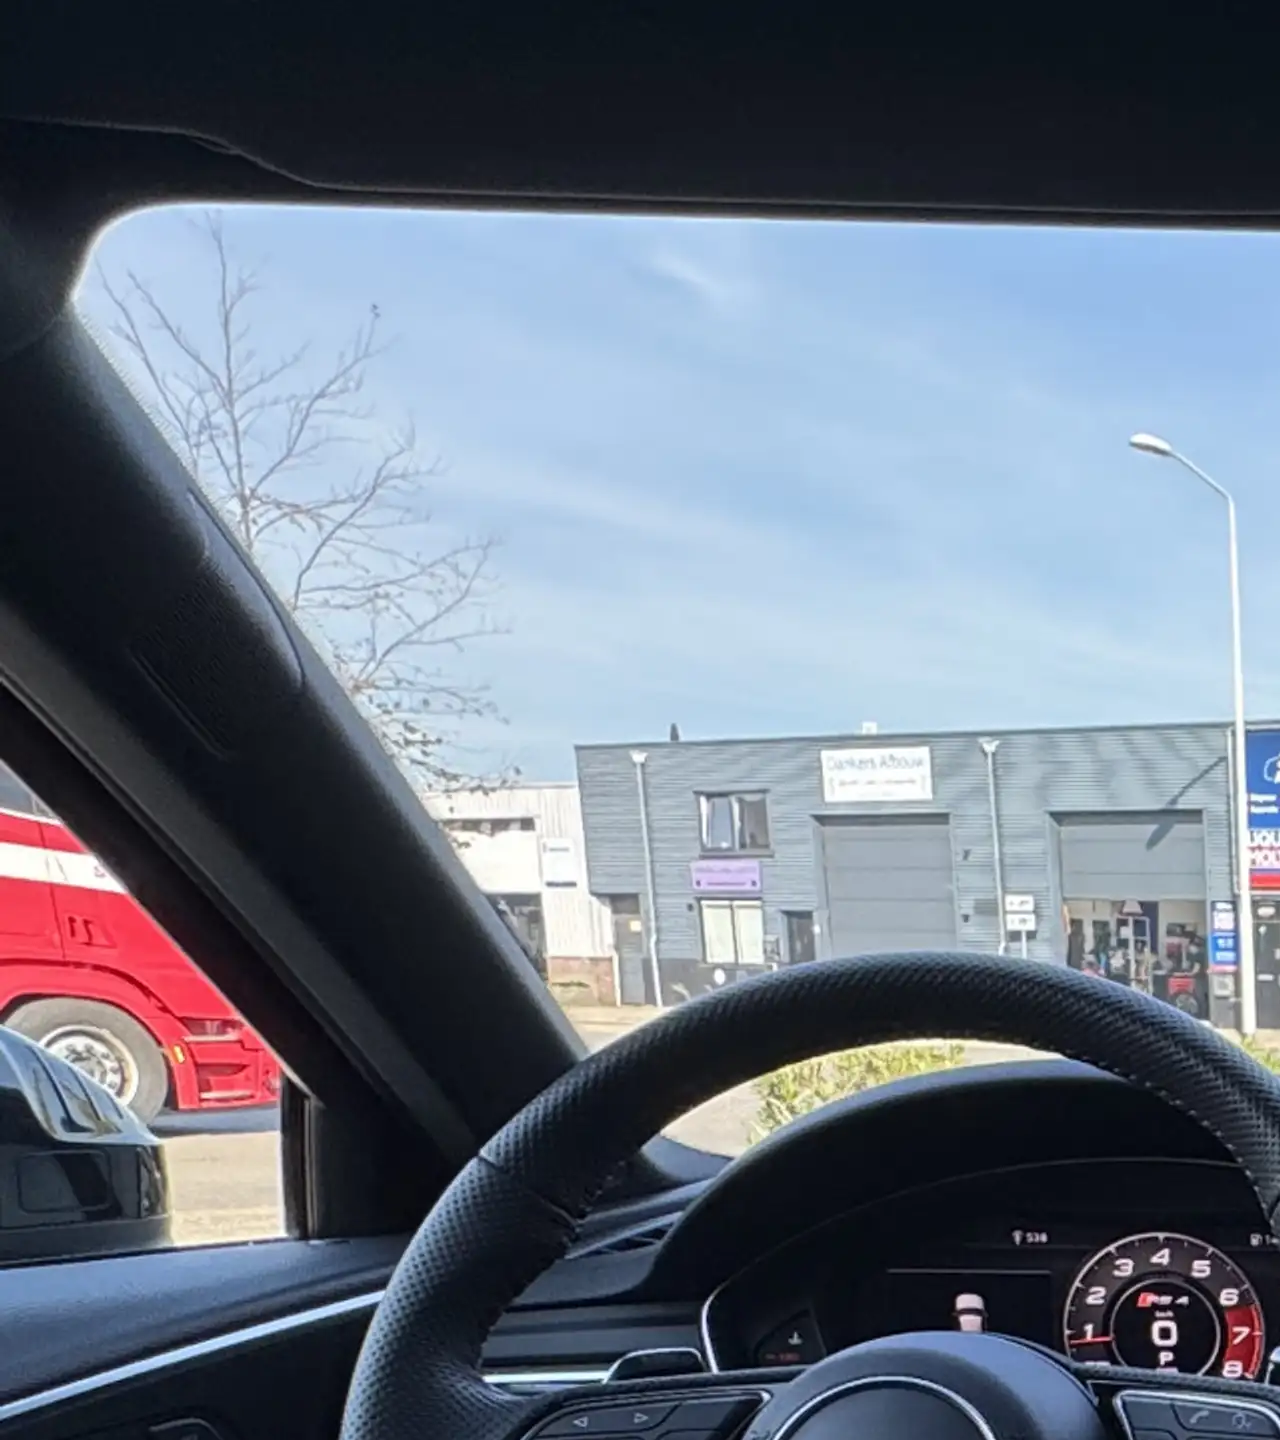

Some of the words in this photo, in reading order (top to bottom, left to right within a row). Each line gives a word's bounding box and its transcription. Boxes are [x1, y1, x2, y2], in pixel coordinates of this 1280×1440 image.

[1150, 1247, 1171, 1266] 4
[1113, 1258, 1135, 1278] 3
[1190, 1260, 1212, 1279] 5
[1085, 1286, 1107, 1305] 2
[1219, 1287, 1240, 1306] 6
[1083, 1323, 1094, 1341] 1
[1150, 1320, 1179, 1348] 0
[1231, 1326, 1250, 1345] 7
[1158, 1350, 1175, 1368] P
[1221, 1360, 1244, 1379] 8
